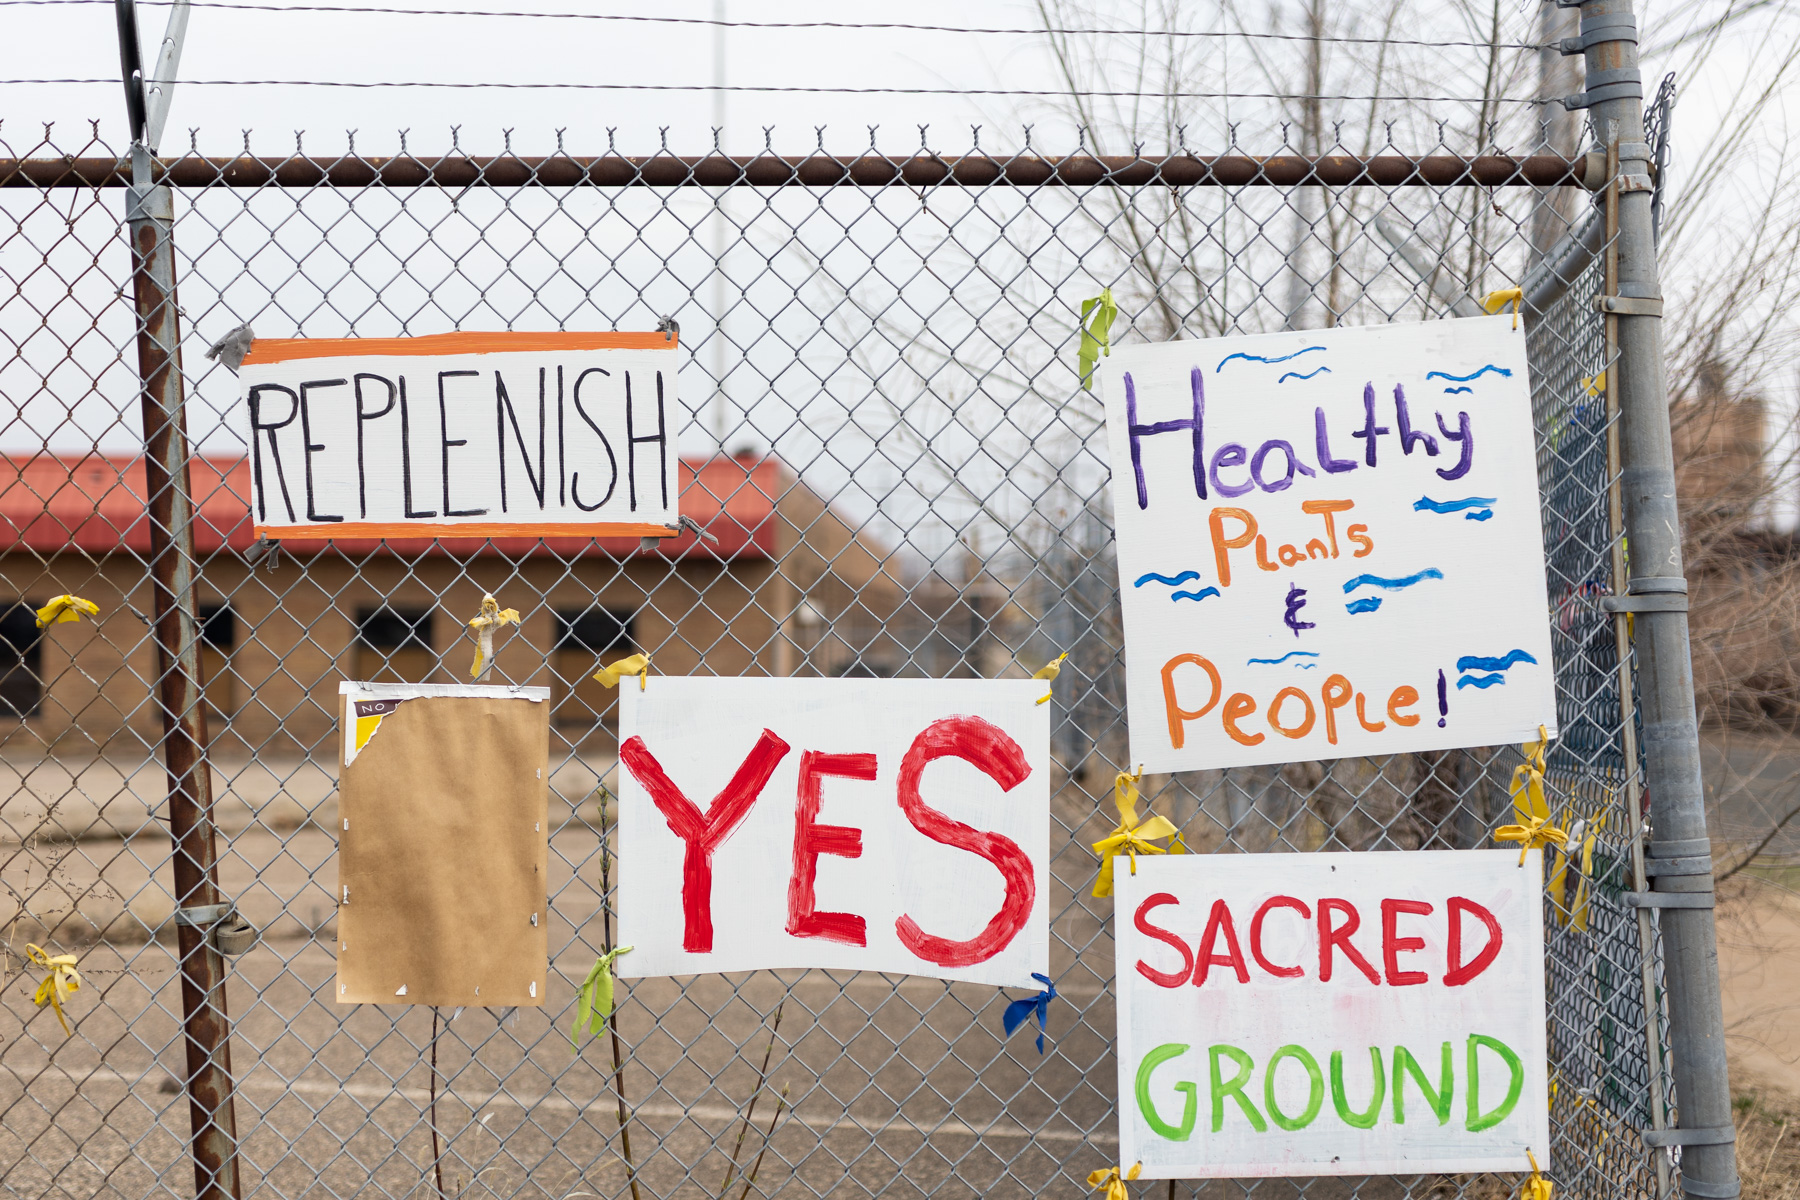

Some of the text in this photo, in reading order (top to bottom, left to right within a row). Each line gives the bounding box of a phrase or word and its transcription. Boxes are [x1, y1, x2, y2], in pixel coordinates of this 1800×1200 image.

[247, 364, 669, 523] REPLENISH
[361, 703, 384, 713] NO
[620, 713, 1036, 968] YES
[1134, 892, 1503, 988] SACRED
[1135, 1033, 1524, 1142] GROUND
